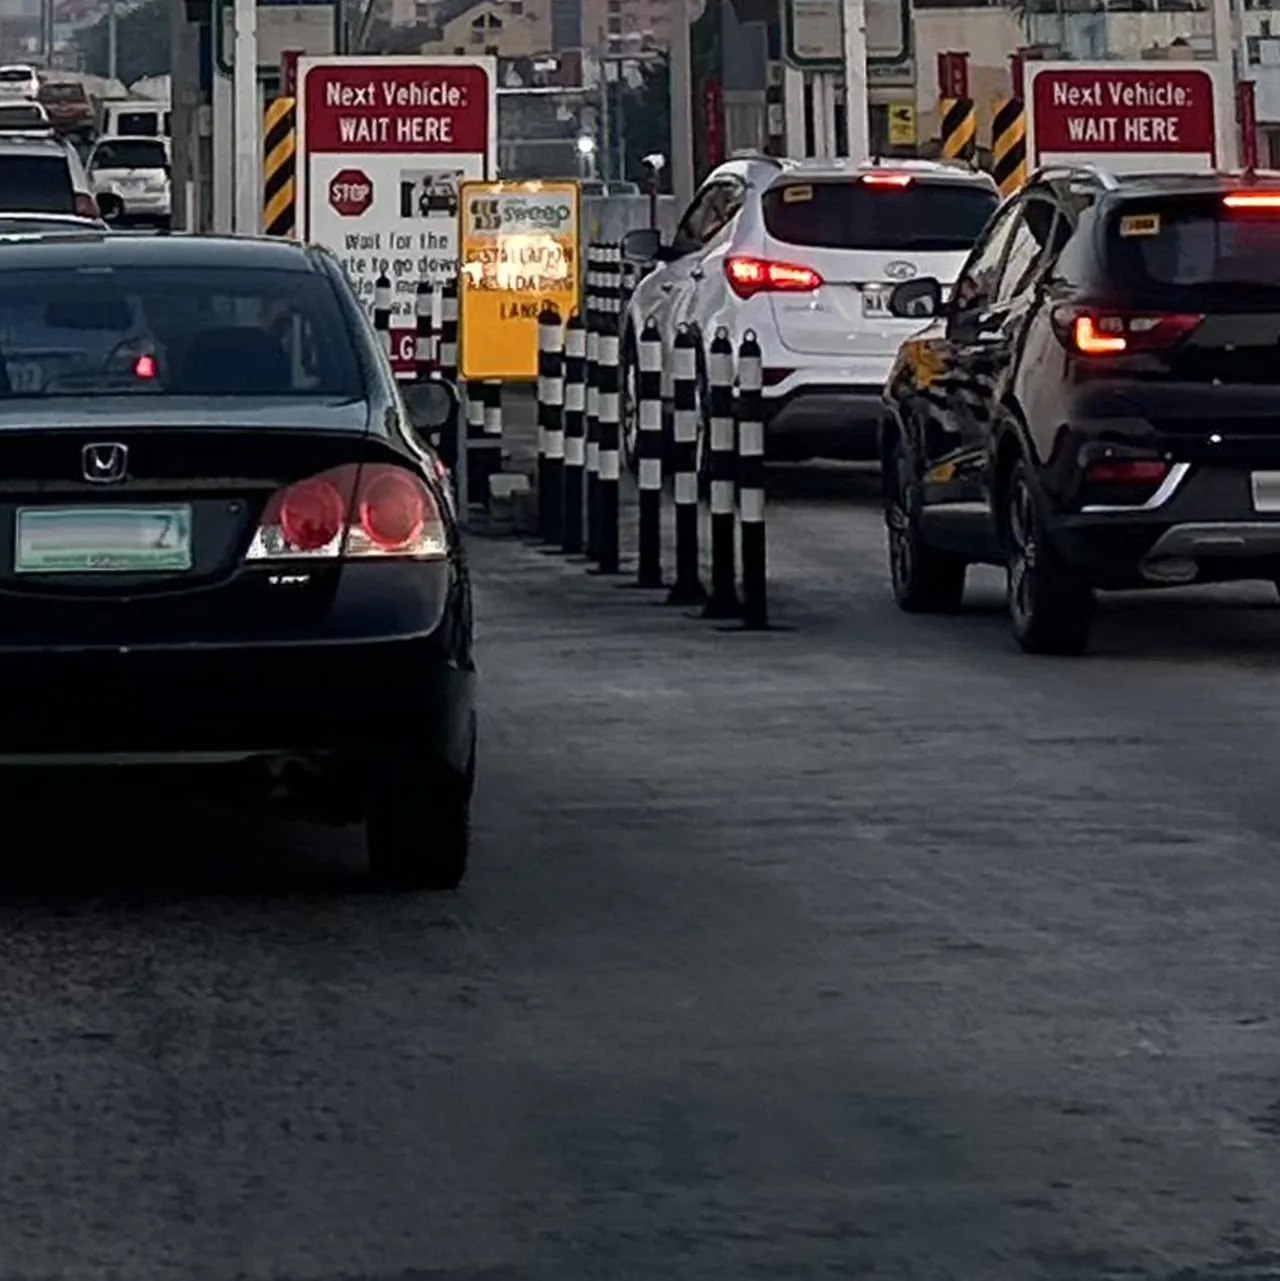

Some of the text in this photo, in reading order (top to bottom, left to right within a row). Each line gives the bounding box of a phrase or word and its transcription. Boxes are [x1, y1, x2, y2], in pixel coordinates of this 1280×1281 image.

[326, 81, 468, 107] Next Vehicle:
[1052, 81, 1193, 107] Next Vehicle:
[339, 117, 453, 142] WAIT HERE
[1067, 117, 1180, 142] WAIT HERE
[331, 183, 370, 203] STOP
[388, 232, 413, 250] for
[419, 232, 449, 250] the
[392, 259, 413, 276] go
